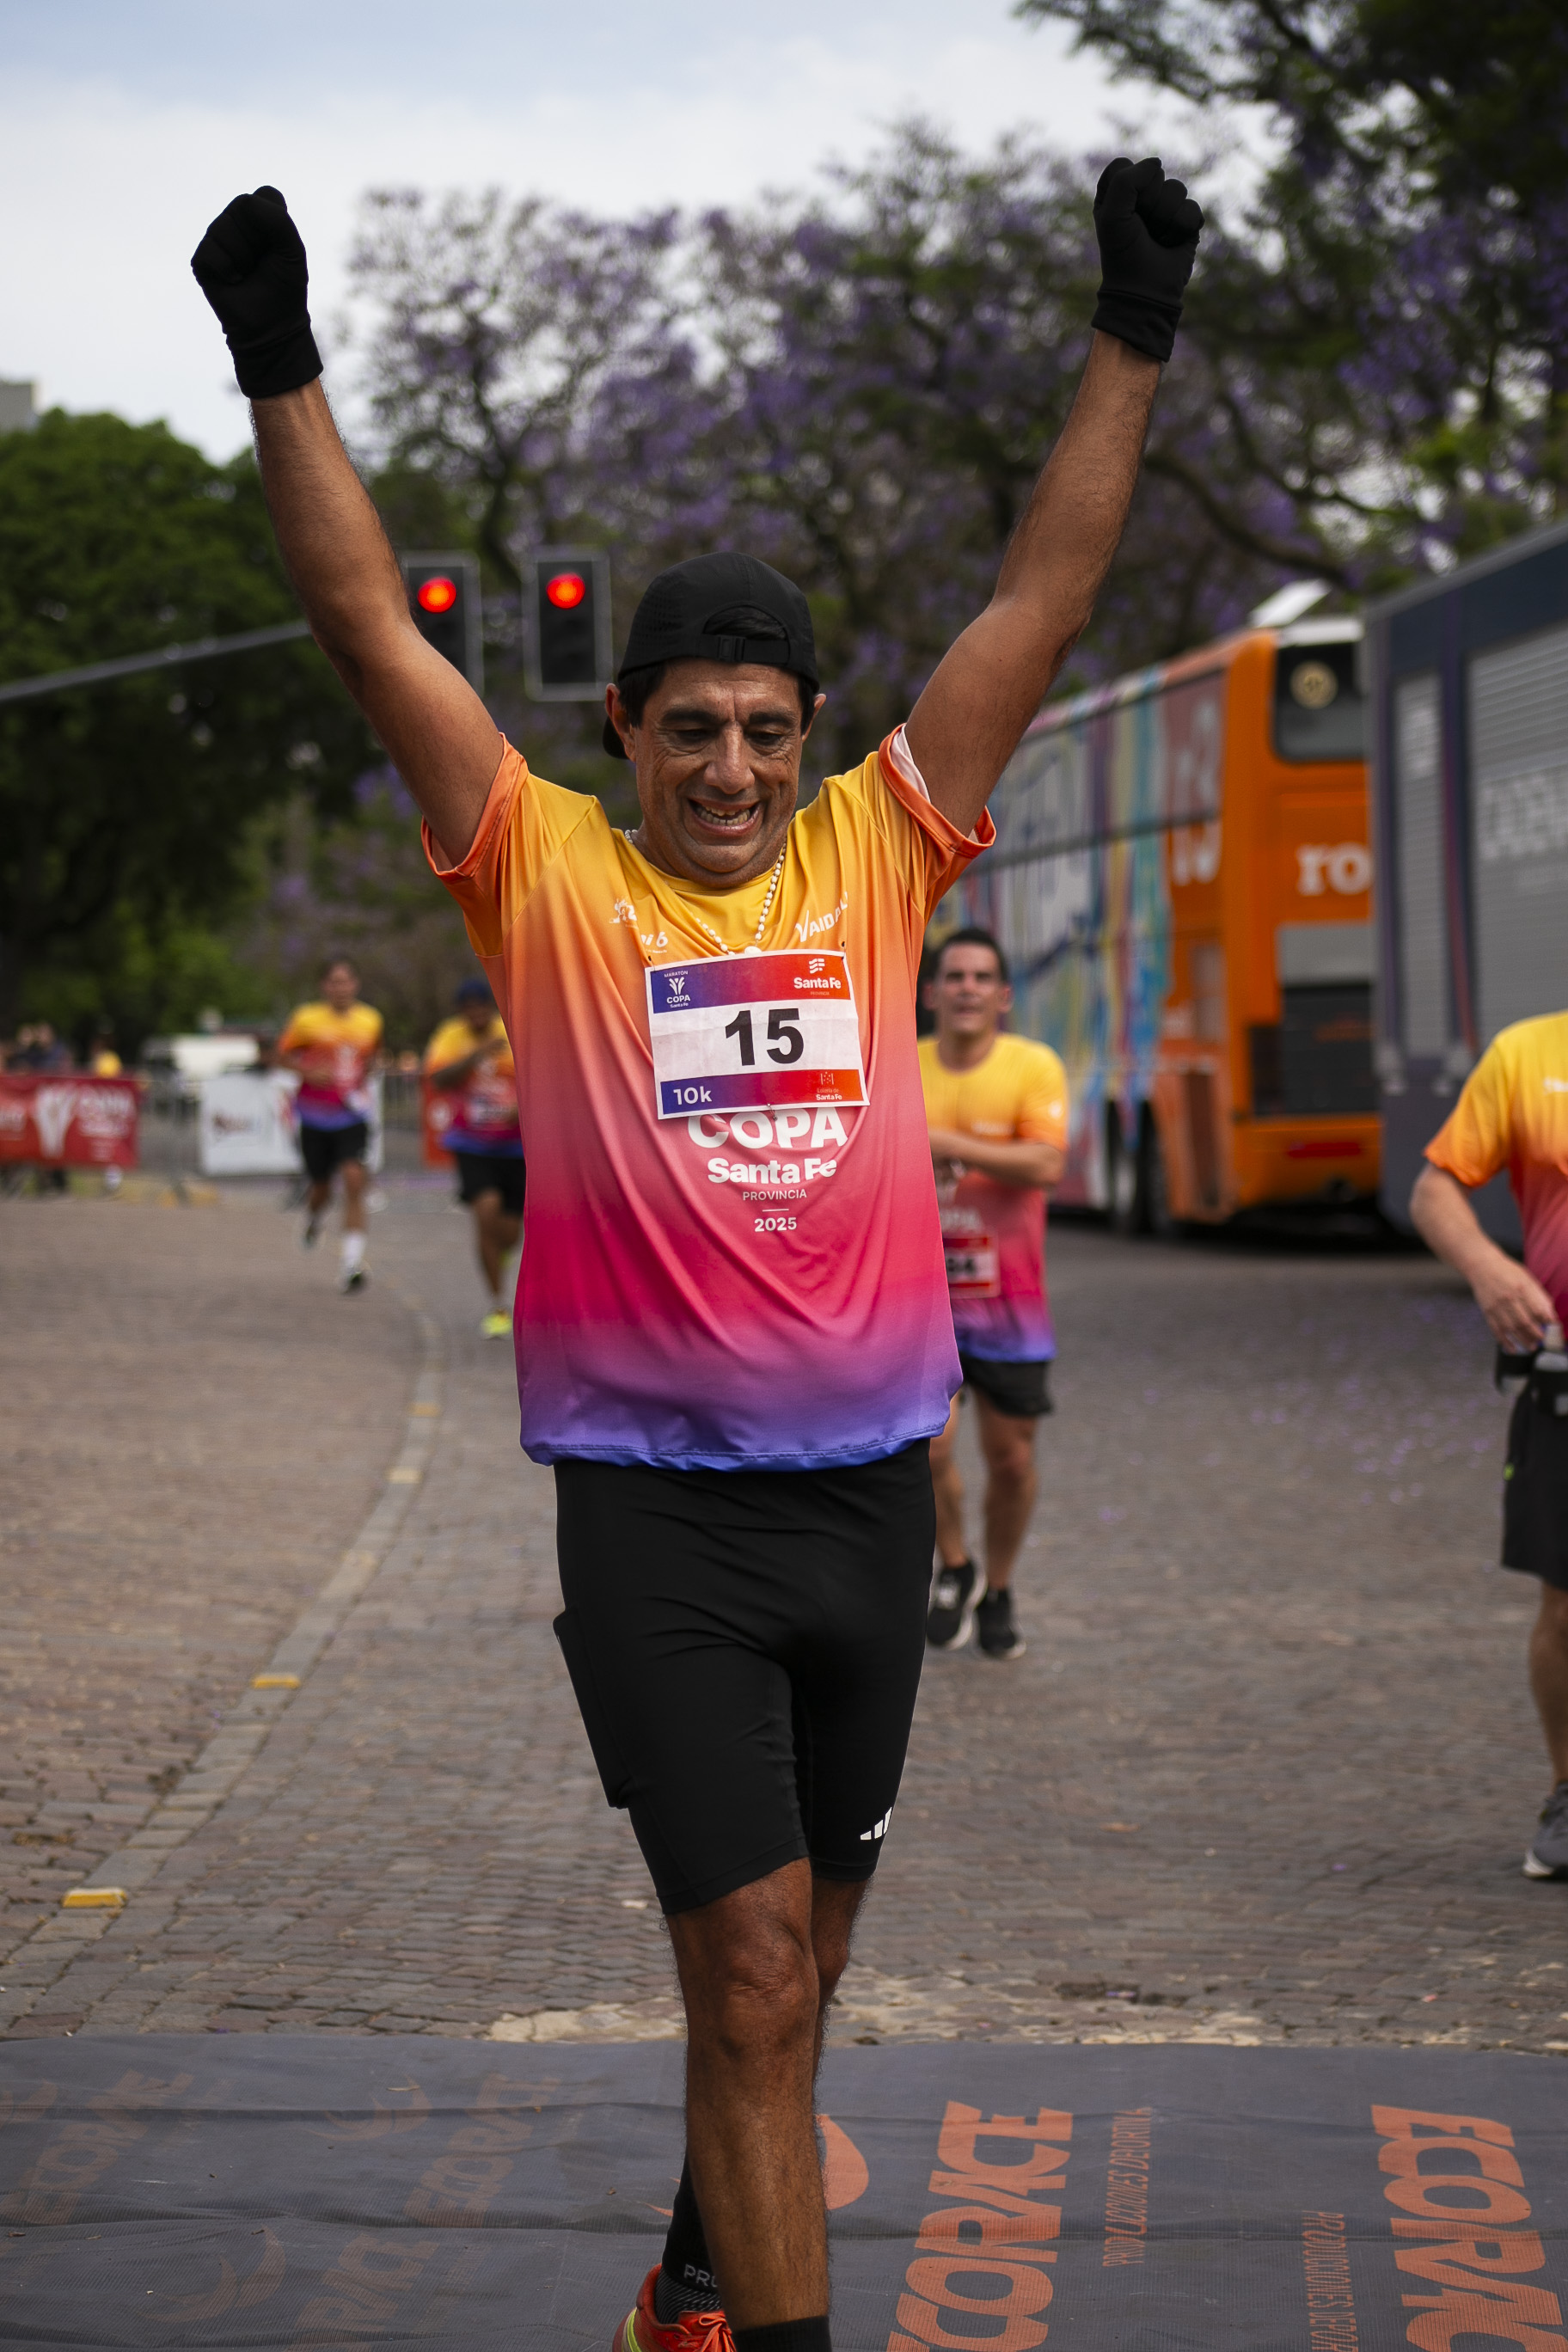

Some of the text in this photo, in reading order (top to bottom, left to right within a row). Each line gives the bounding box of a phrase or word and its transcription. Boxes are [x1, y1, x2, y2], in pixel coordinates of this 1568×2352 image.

[793, 977, 842, 989] Santa Fe
[666, 995, 691, 1004] COPA
[725, 1008, 804, 1066] 15
[673, 1087, 712, 1106] 10k
[689, 1106, 848, 1149] COPA
[707, 1157, 837, 1185] Santa Fe
[743, 1189, 807, 1202] PROVINCIA
[754, 1217, 797, 1233] 2025
[886, 2100, 1073, 2352] CORACE
[1301, 2210, 1355, 2308] PRODUCCIONES
